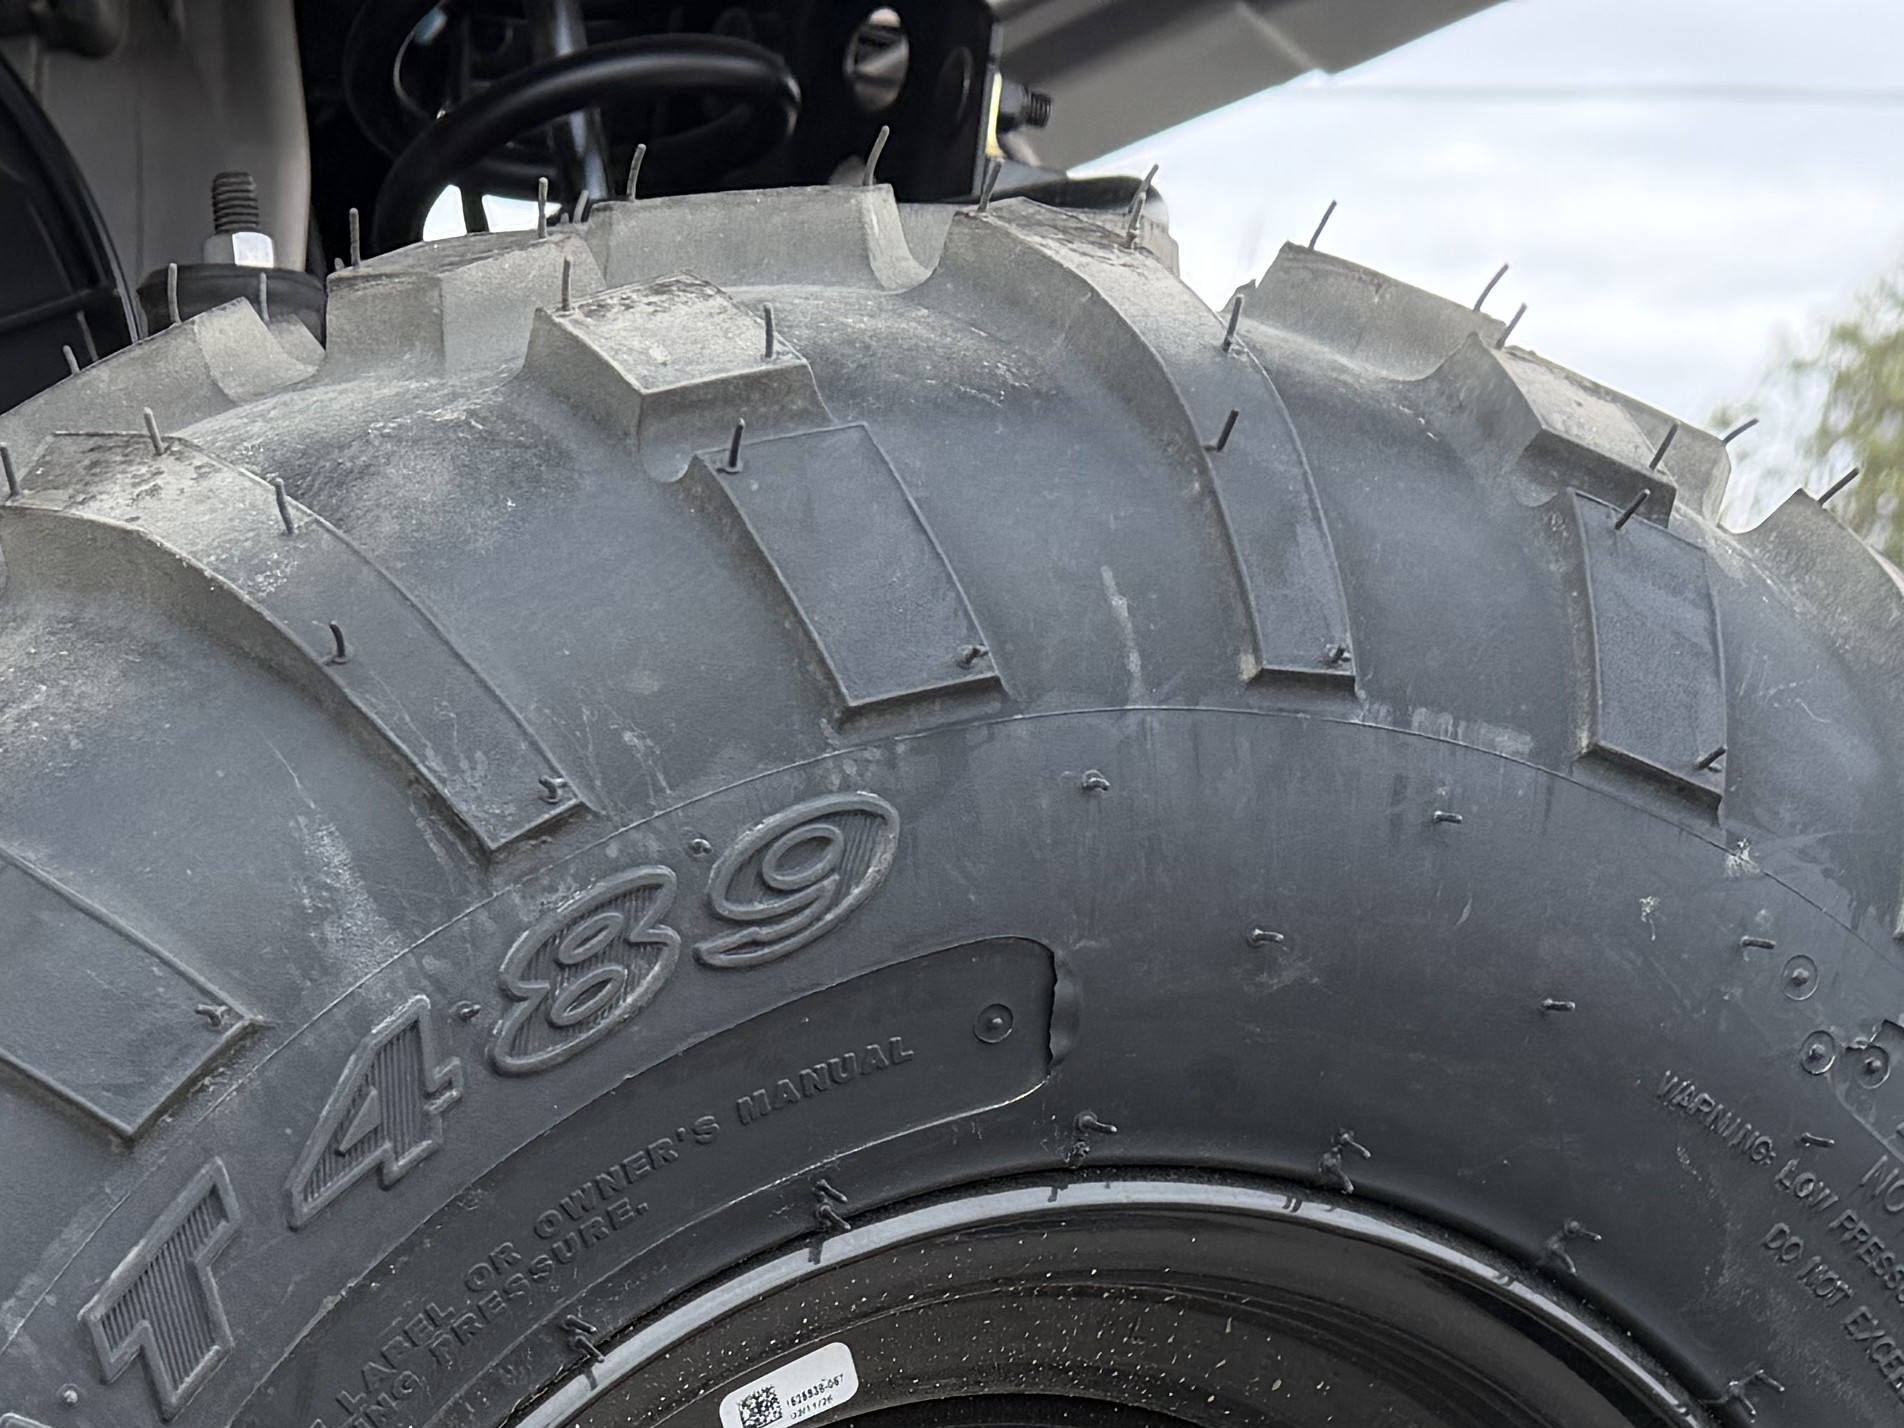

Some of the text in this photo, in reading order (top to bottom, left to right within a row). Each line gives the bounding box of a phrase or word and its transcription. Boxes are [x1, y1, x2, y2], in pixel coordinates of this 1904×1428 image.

[335, 1301, 457, 1418] LABEL
[463, 1241, 523, 1294] OR
[533, 1113, 720, 1240] OWNER'S
[736, 1034, 916, 1127] MANUAL
[1775, 1157, 1839, 1213] LOW
[427, 1197, 650, 1368] PRESSURE.
[1760, 1221, 1804, 1267] DO
[1795, 1254, 1855, 1310] NOT
